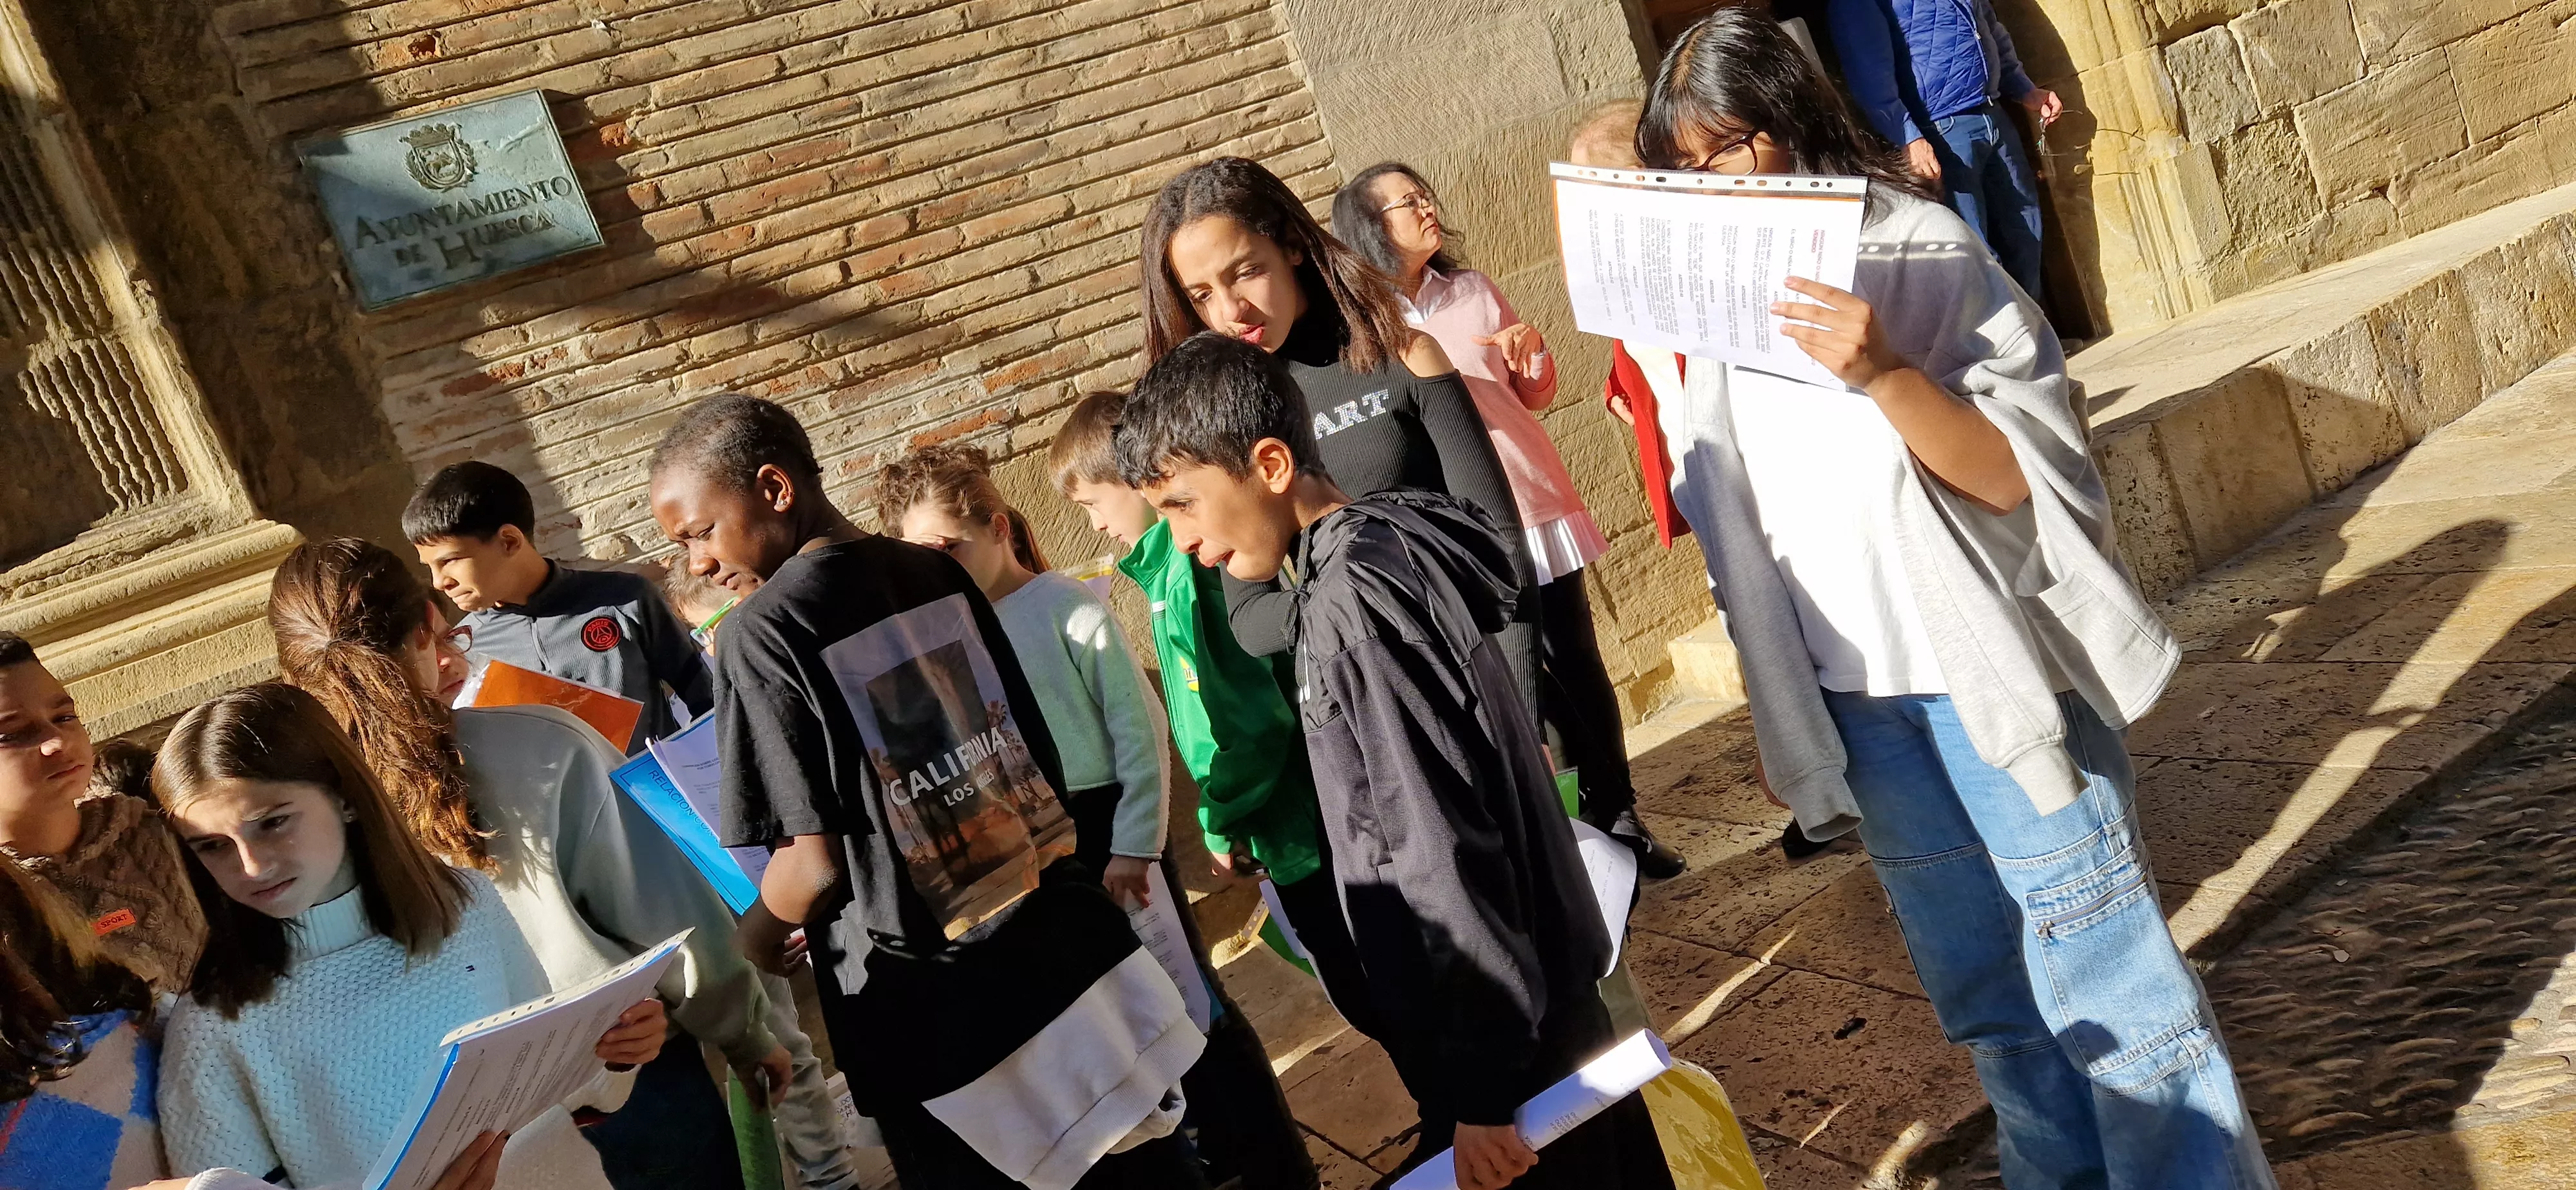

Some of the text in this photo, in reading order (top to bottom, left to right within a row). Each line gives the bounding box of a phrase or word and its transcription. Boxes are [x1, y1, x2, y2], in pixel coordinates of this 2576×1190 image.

[355, 176, 573, 250] AYUNTAMIENTO
[395, 209, 556, 270] DE HUESCA
[1313, 388, 1390, 440] ART
[587, 620, 609, 632] PARIS
[943, 782, 974, 807] LOS
[100, 913, 128, 929] SPORT
